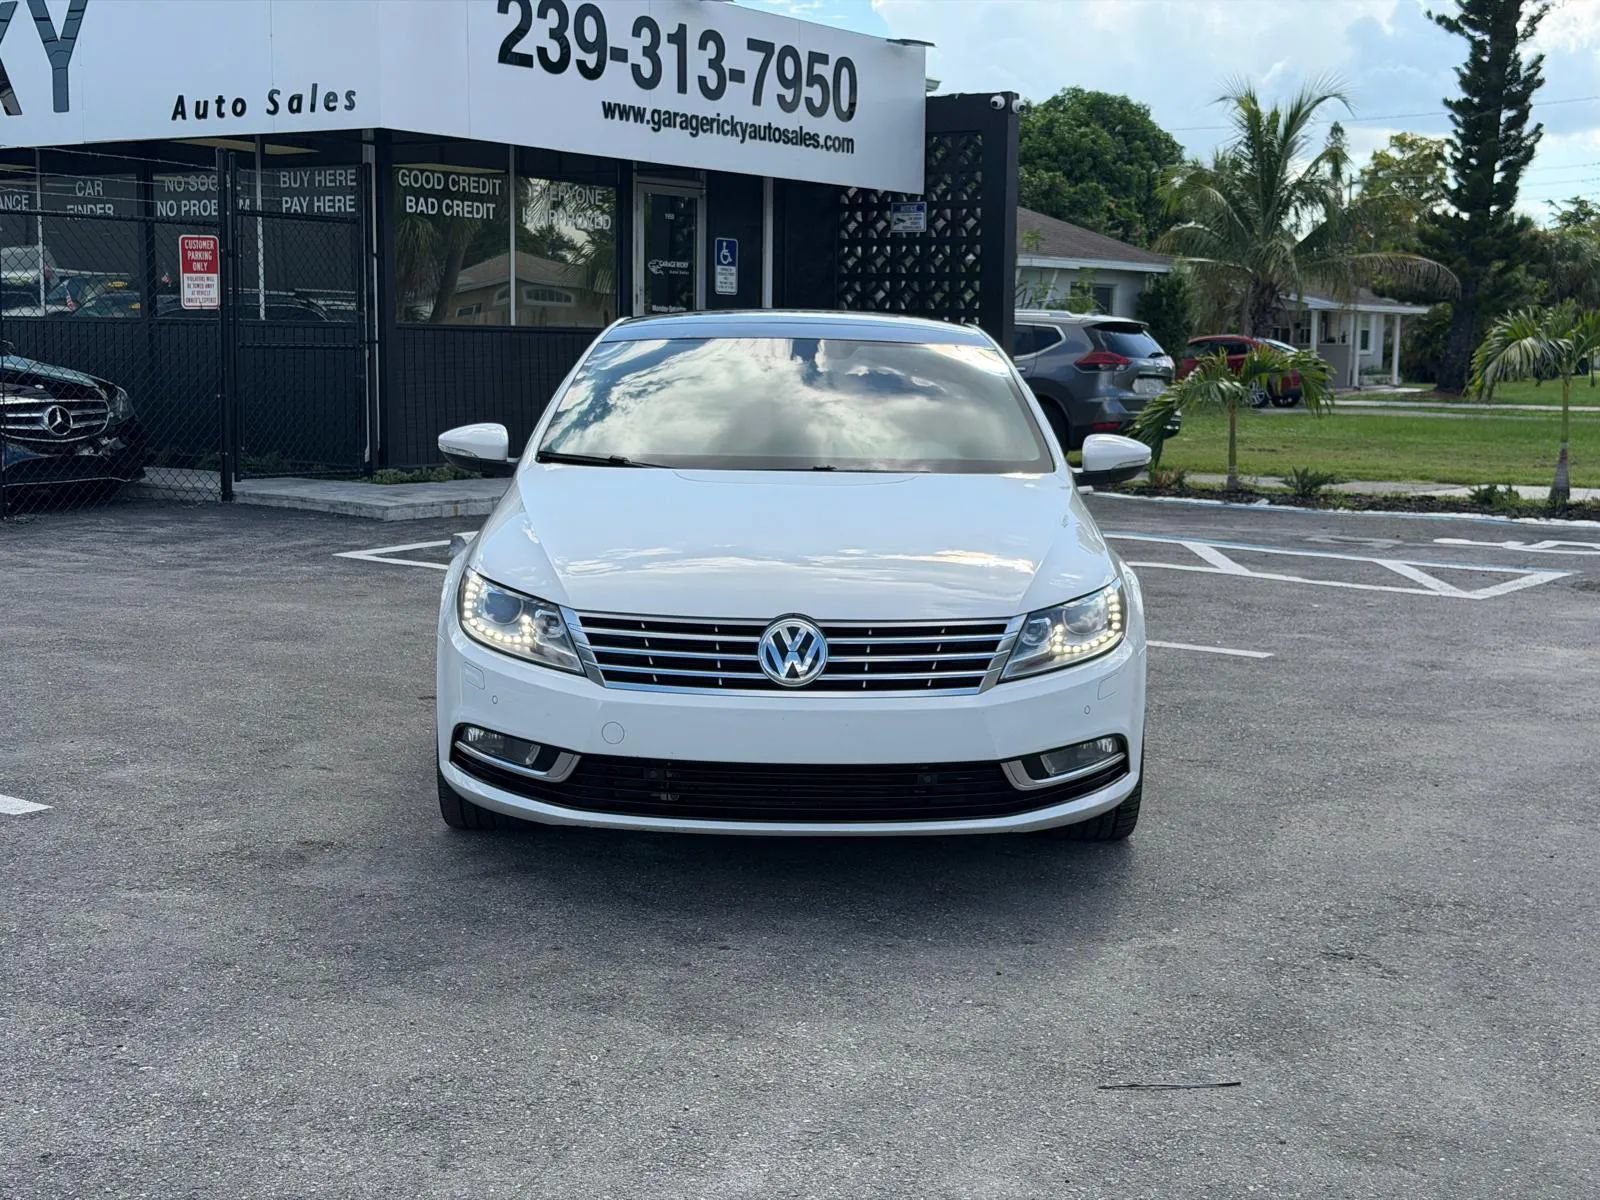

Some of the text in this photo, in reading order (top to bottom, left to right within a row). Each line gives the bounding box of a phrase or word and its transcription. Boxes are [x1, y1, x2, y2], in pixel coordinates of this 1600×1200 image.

[497, 0, 857, 122] 239-313-7950
[171, 83, 356, 121] Auto Sales
[601, 101, 855, 154] www.garagerickyautosales.com
[164, 176, 184, 192] NO
[280, 170, 357, 188] BUY HERE
[398, 169, 502, 196] GOOD CREDIT
[75, 181, 103, 197] CAR
[157, 200, 177, 217] NO
[282, 196, 356, 213] PAY HERE
[405, 196, 496, 220] BAD CREDIT
[184, 239, 215, 250] CUSTOMER
[187, 250, 213, 261] PARKING
[192, 262, 208, 271] ONLY
